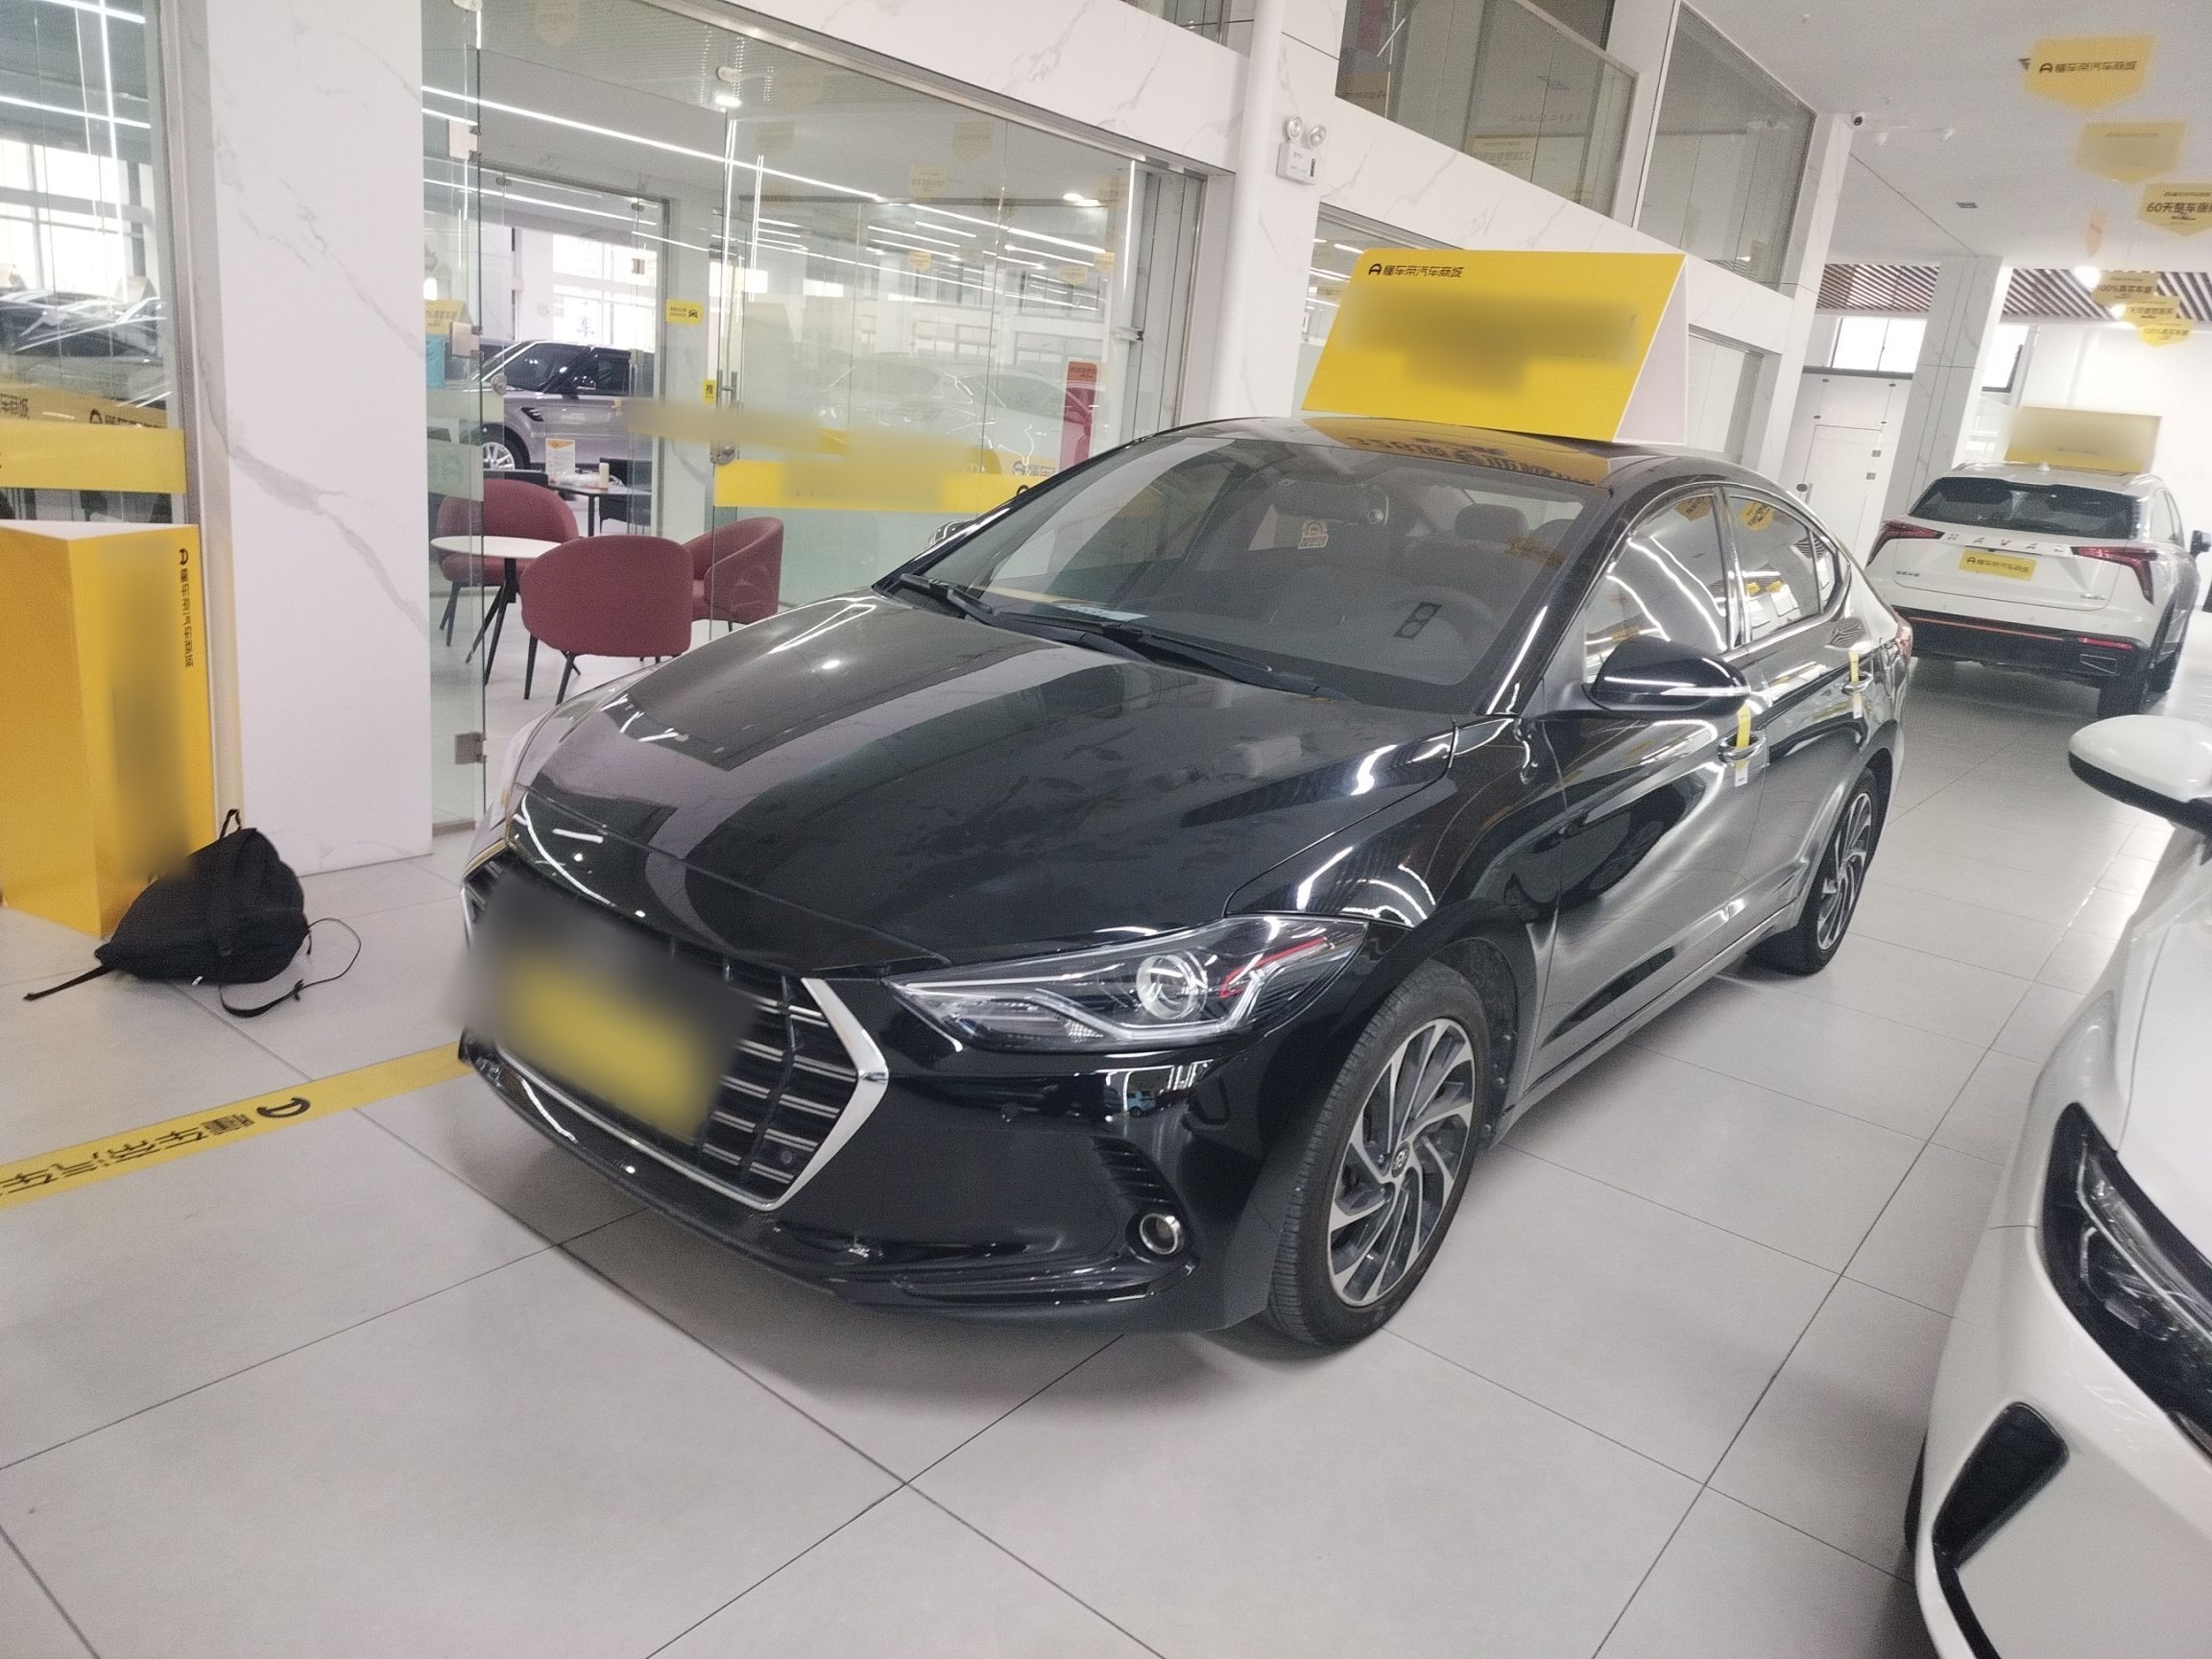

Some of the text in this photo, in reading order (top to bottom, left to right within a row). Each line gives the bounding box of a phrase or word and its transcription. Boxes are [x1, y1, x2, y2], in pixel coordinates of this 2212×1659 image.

[1383, 264, 1464, 278] 懂车帝汽车商城
